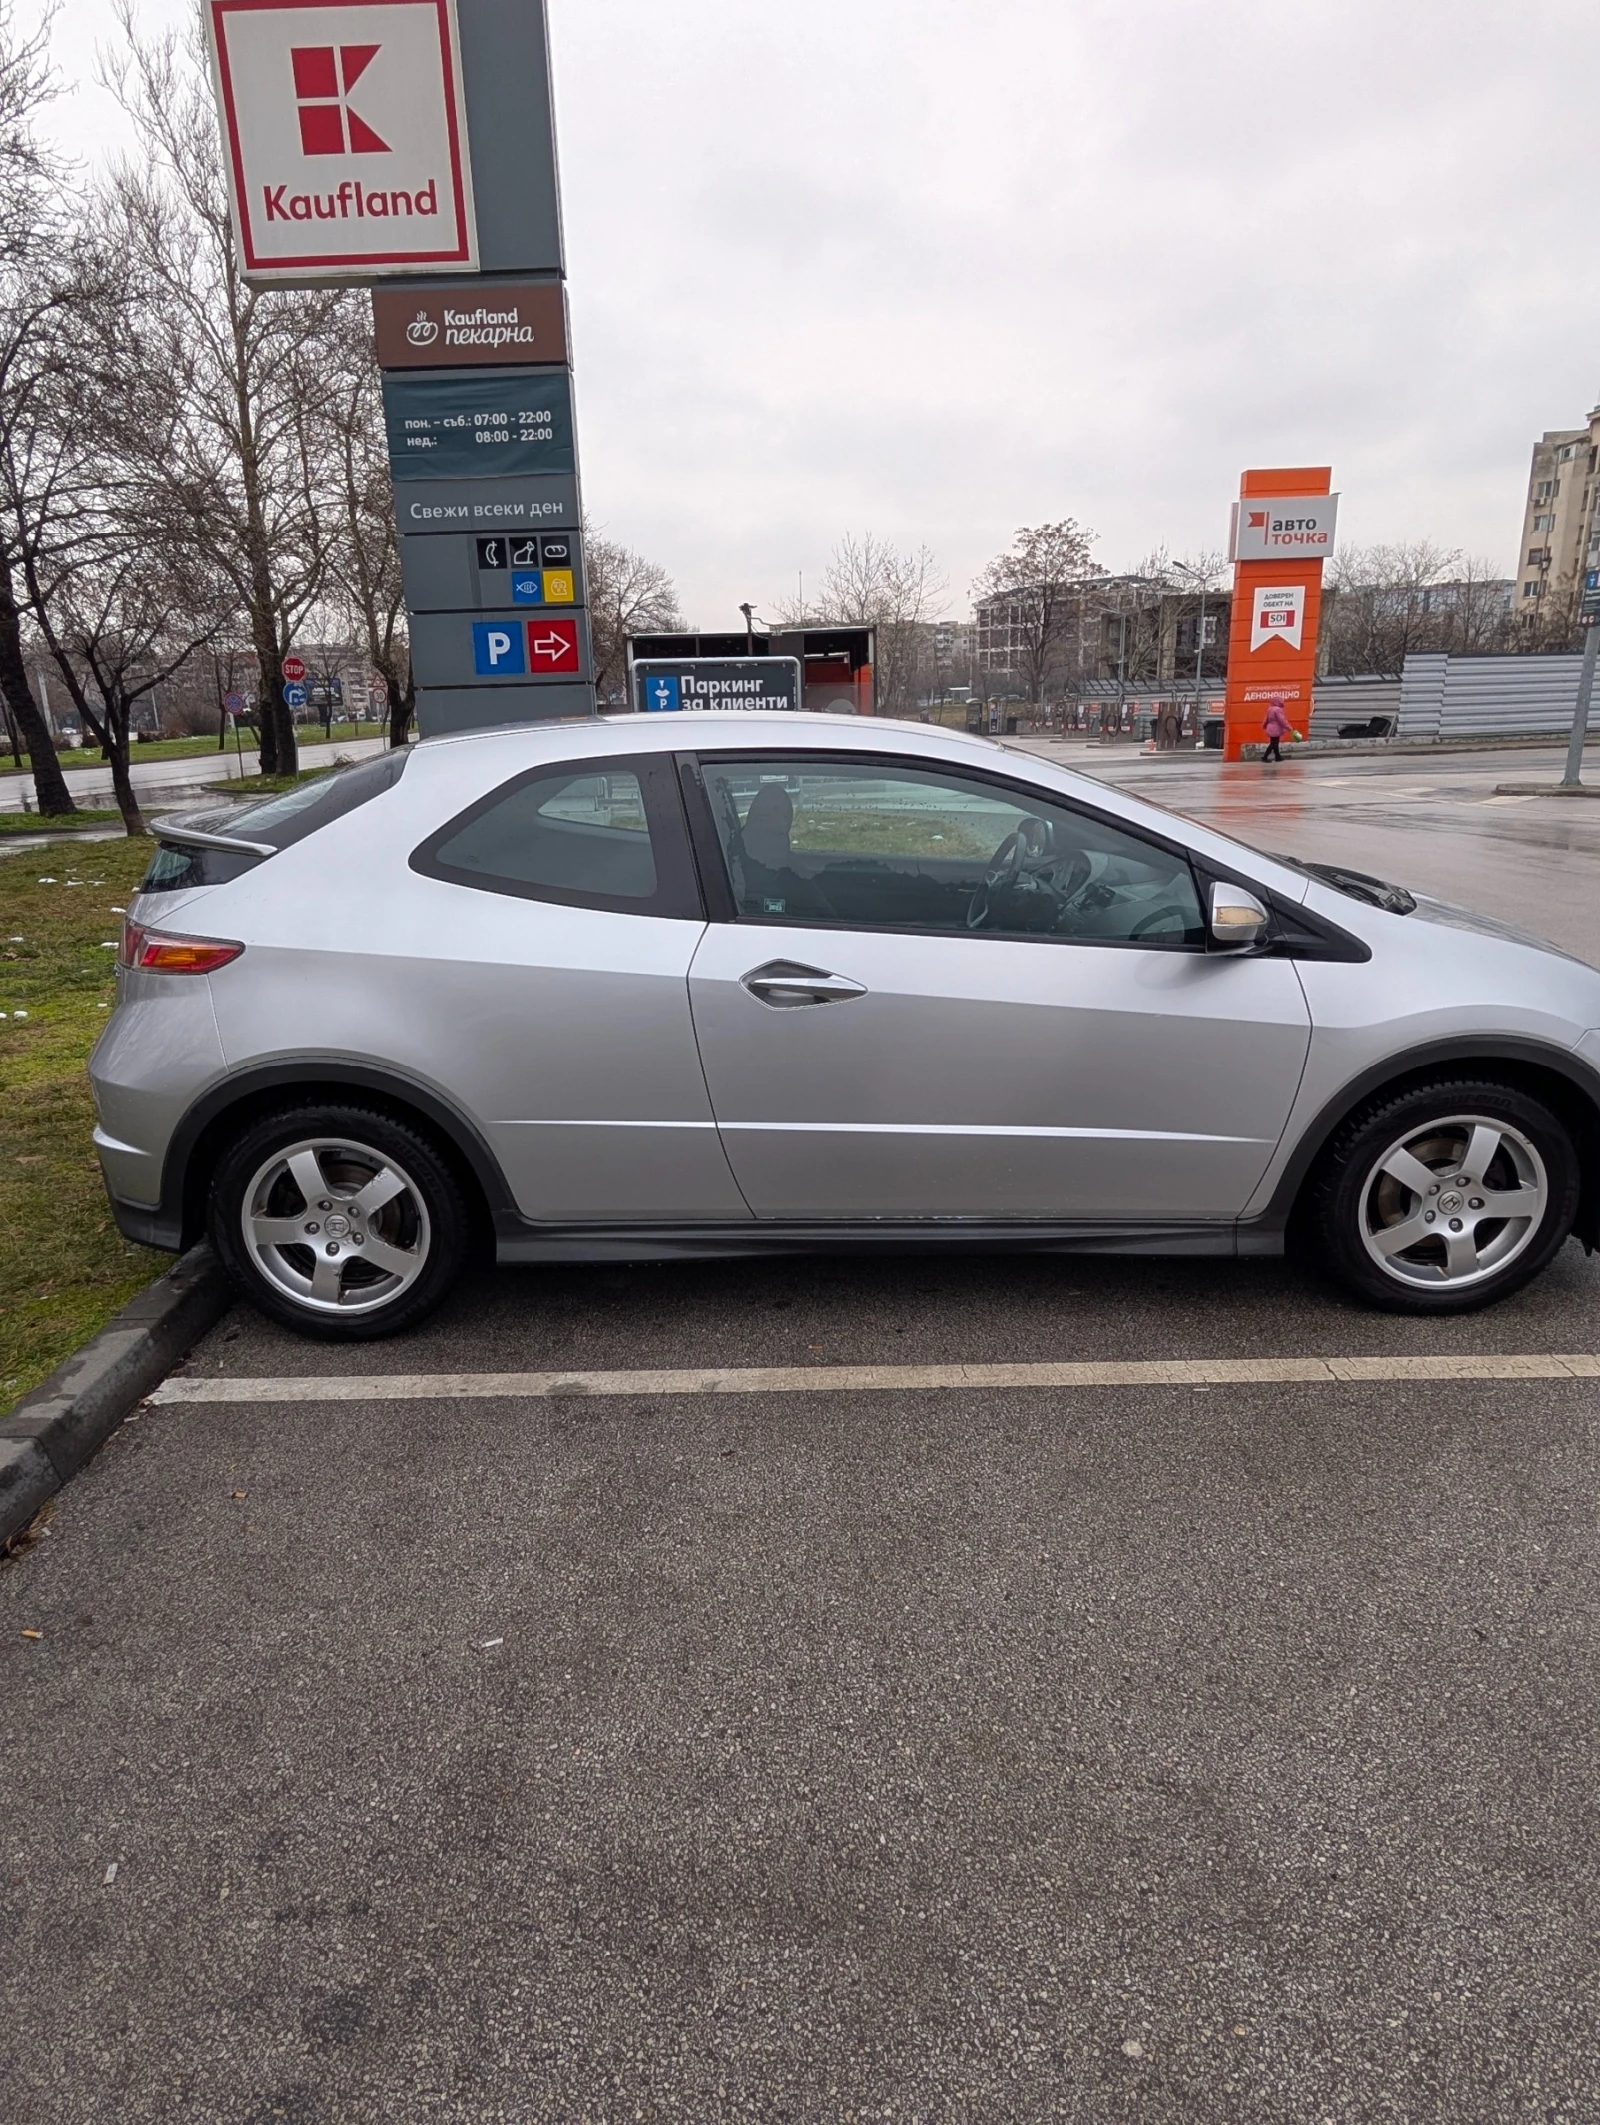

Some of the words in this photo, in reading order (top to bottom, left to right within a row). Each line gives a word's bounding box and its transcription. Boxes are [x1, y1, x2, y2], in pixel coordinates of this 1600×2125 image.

[263, 179, 438, 222] Kaufland
[444, 307, 518, 326] Kaufland
[445, 326, 535, 348] пекарна
[405, 418, 431, 429] пон.
[443, 415, 471, 428] съб.:
[474, 412, 507, 426] 07:00
[518, 410, 551, 424] 22:00
[407, 435, 437, 447] нед.:
[475, 430, 509, 443] 08:00
[520, 428, 553, 441] 22:00
[410, 503, 469, 519] Свежи
[474, 502, 524, 517] всеки
[529, 502, 563, 518] ден
[1272, 518, 1317, 531] авто
[1272, 532, 1328, 545] точка
[488, 632, 510, 665] P
[285, 664, 304, 675] STOP
[680, 675, 764, 698] Паркинг
[681, 698, 704, 711] за
[710, 696, 788, 711] клиенти
